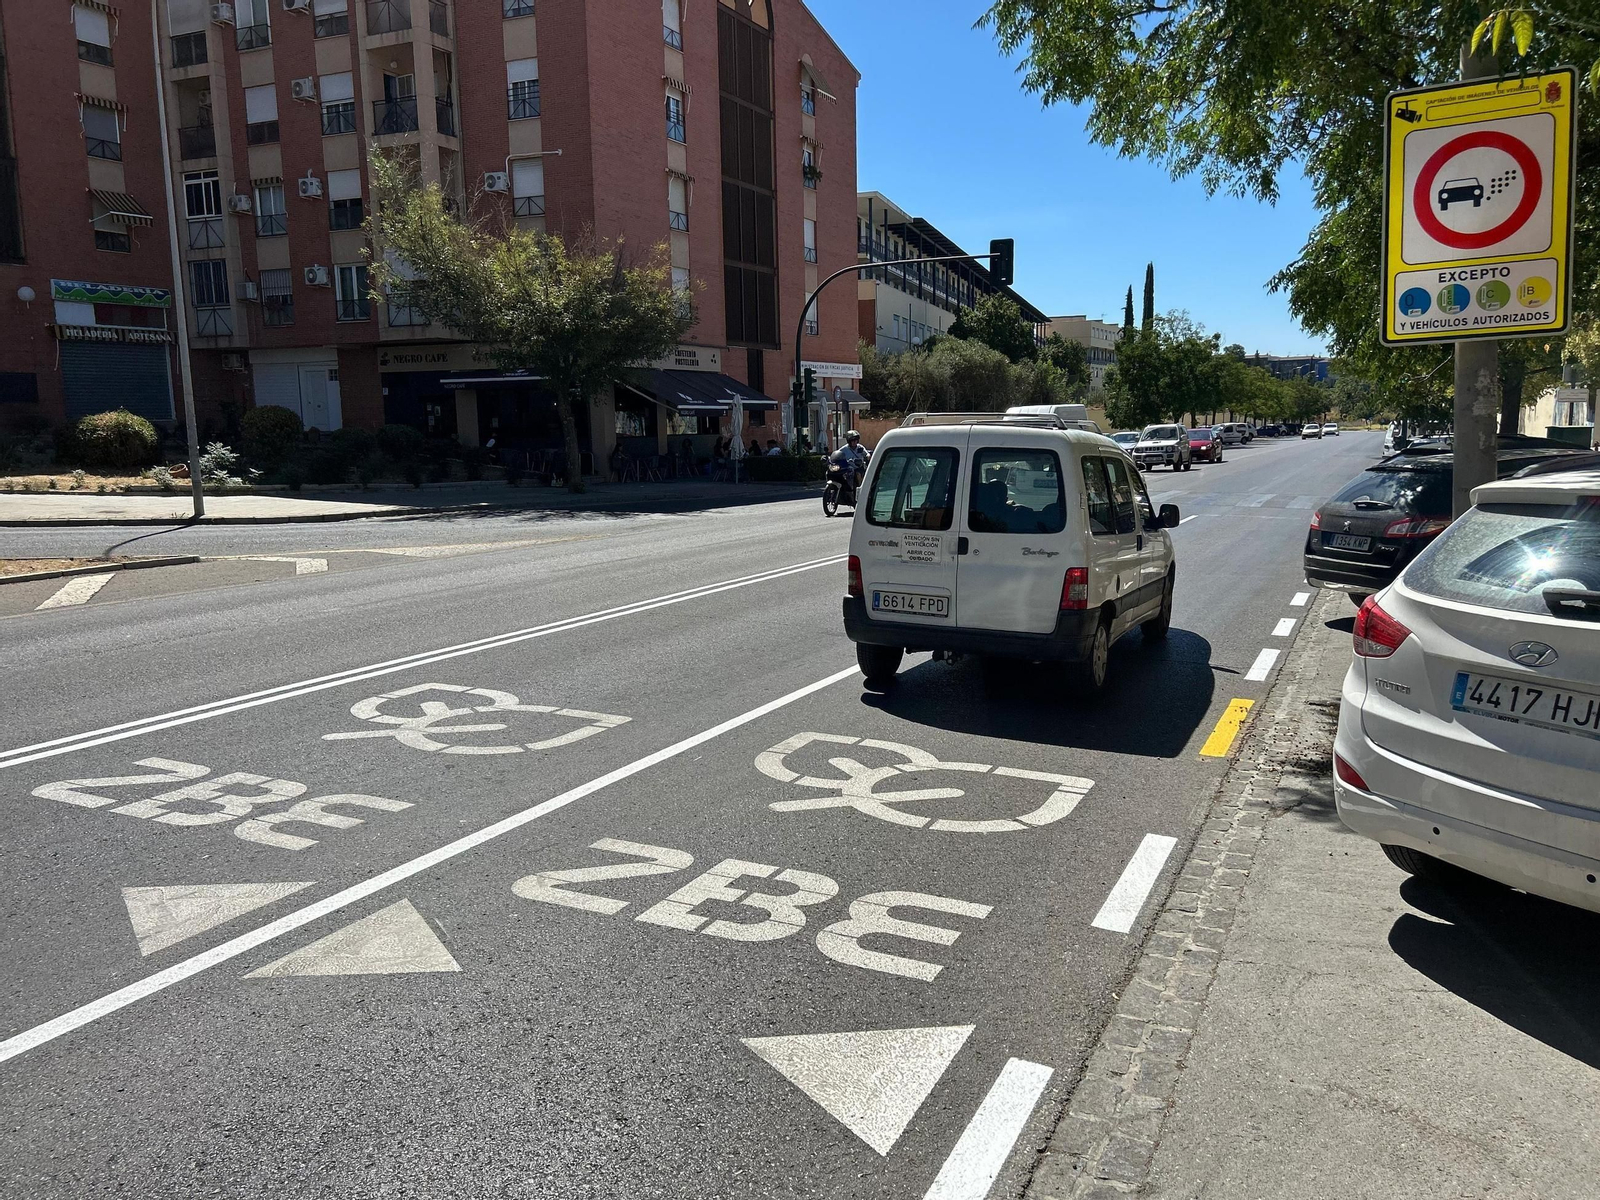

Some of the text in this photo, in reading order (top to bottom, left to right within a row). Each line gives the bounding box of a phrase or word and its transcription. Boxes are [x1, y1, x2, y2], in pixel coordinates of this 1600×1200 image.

[1426, 96, 1457, 105] CAPTACIÓN
[1467, 91, 1496, 99] IMÁGENES
[1438, 267, 1511, 283] EXCEPTO
[1486, 290, 1495, 299] C
[1527, 286, 1536, 295] B
[1400, 311, 1550, 331] Y VEHÍCULOS AUTORIZADOS
[128, 333, 172, 342] ARTESANA
[393, 352, 448, 364] NEGRO CAFÉ
[1021, 547, 1060, 558] Berlingo
[883, 595, 944, 612] 6614 FPD
[1469, 679, 1600, 730] 4417 HJ
